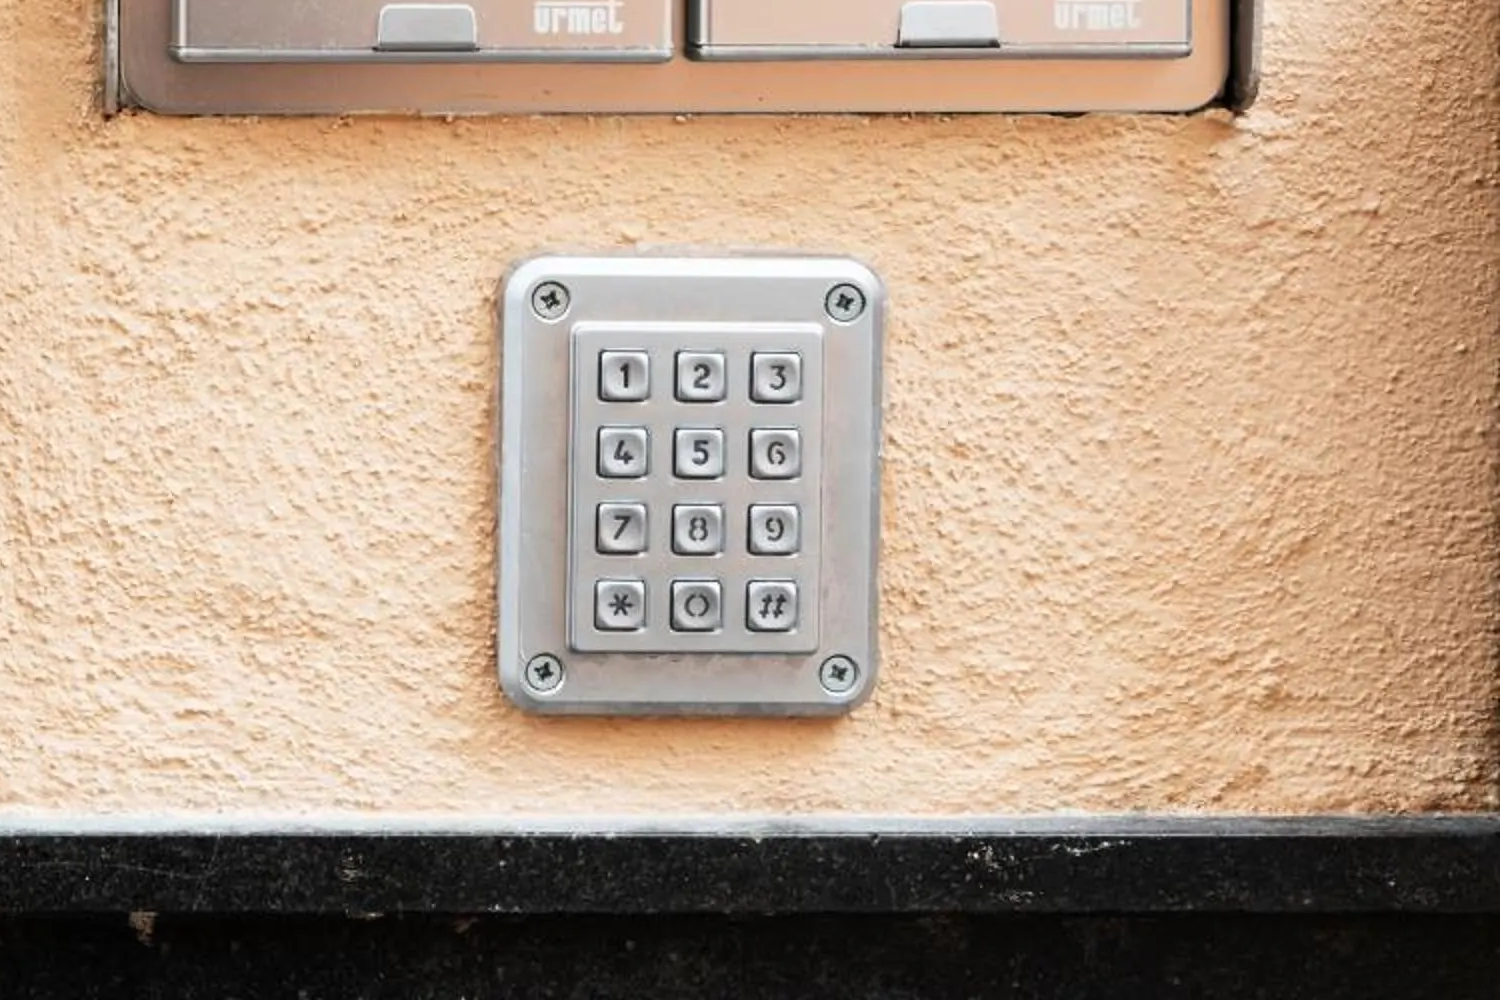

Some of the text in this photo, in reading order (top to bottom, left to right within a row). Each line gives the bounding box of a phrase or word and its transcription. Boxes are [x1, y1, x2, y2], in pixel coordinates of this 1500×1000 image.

[619, 362, 787, 391] 1 2 3
[613, 439, 786, 466] 4 5 6
[613, 515, 785, 542] 7 8 9
[684, 593, 710, 618] 0
